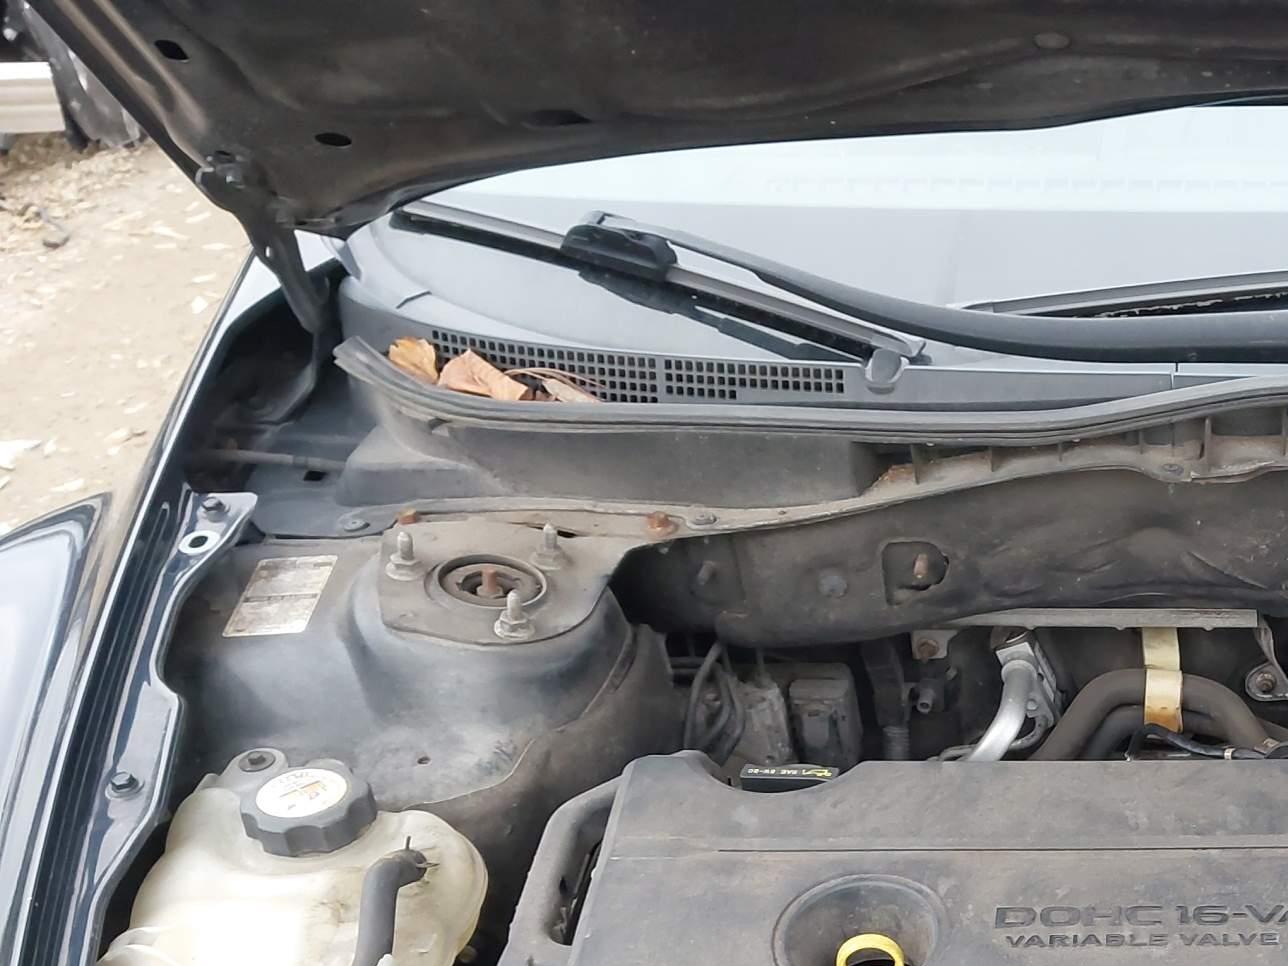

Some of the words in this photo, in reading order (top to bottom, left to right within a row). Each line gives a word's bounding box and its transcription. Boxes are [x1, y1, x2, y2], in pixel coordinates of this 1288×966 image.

[994, 905, 1164, 929] DOHC
[1005, 932, 1169, 948] VARIABLE
[1179, 931, 1280, 946] VALVE
